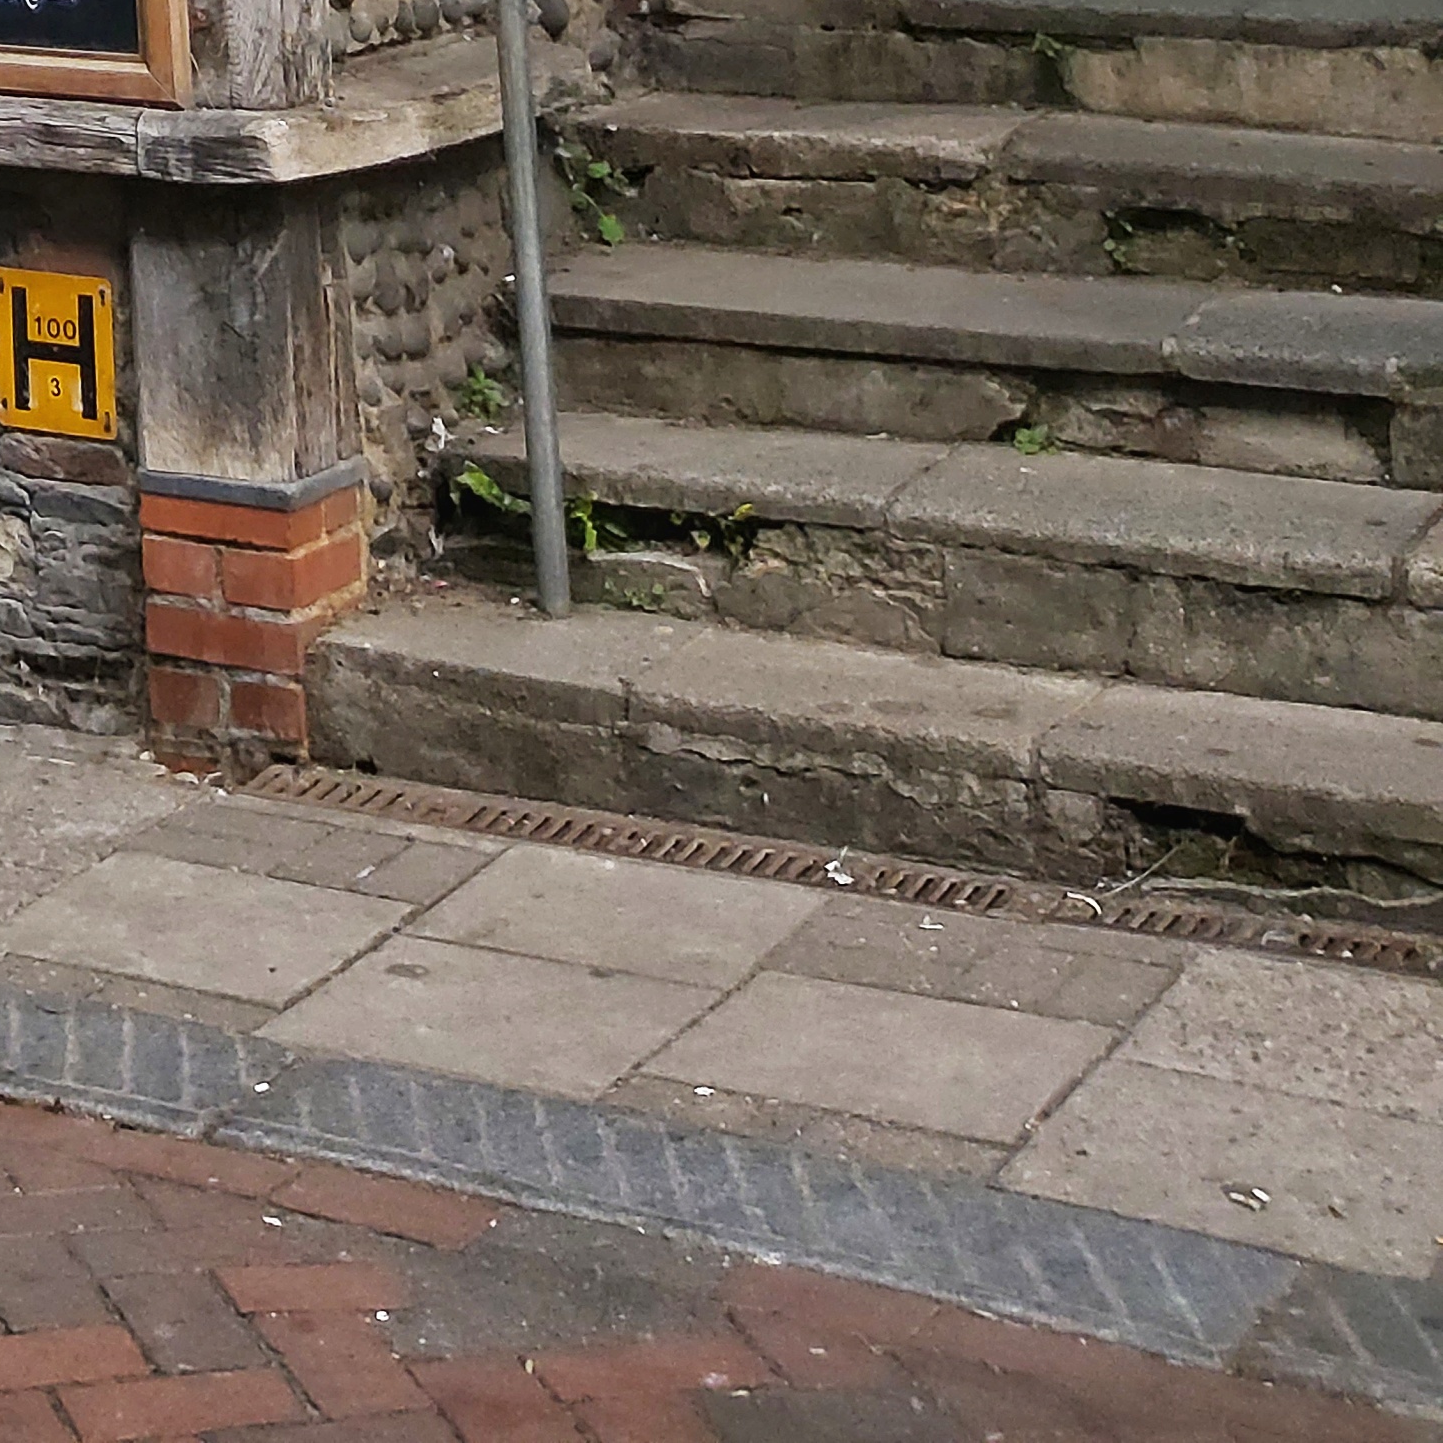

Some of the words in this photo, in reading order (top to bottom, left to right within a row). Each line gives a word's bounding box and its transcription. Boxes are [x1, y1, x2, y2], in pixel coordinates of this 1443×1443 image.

[34, 316, 77, 340] 100
[12, 286, 98, 421] H
[49, 377, 62, 397] 3
